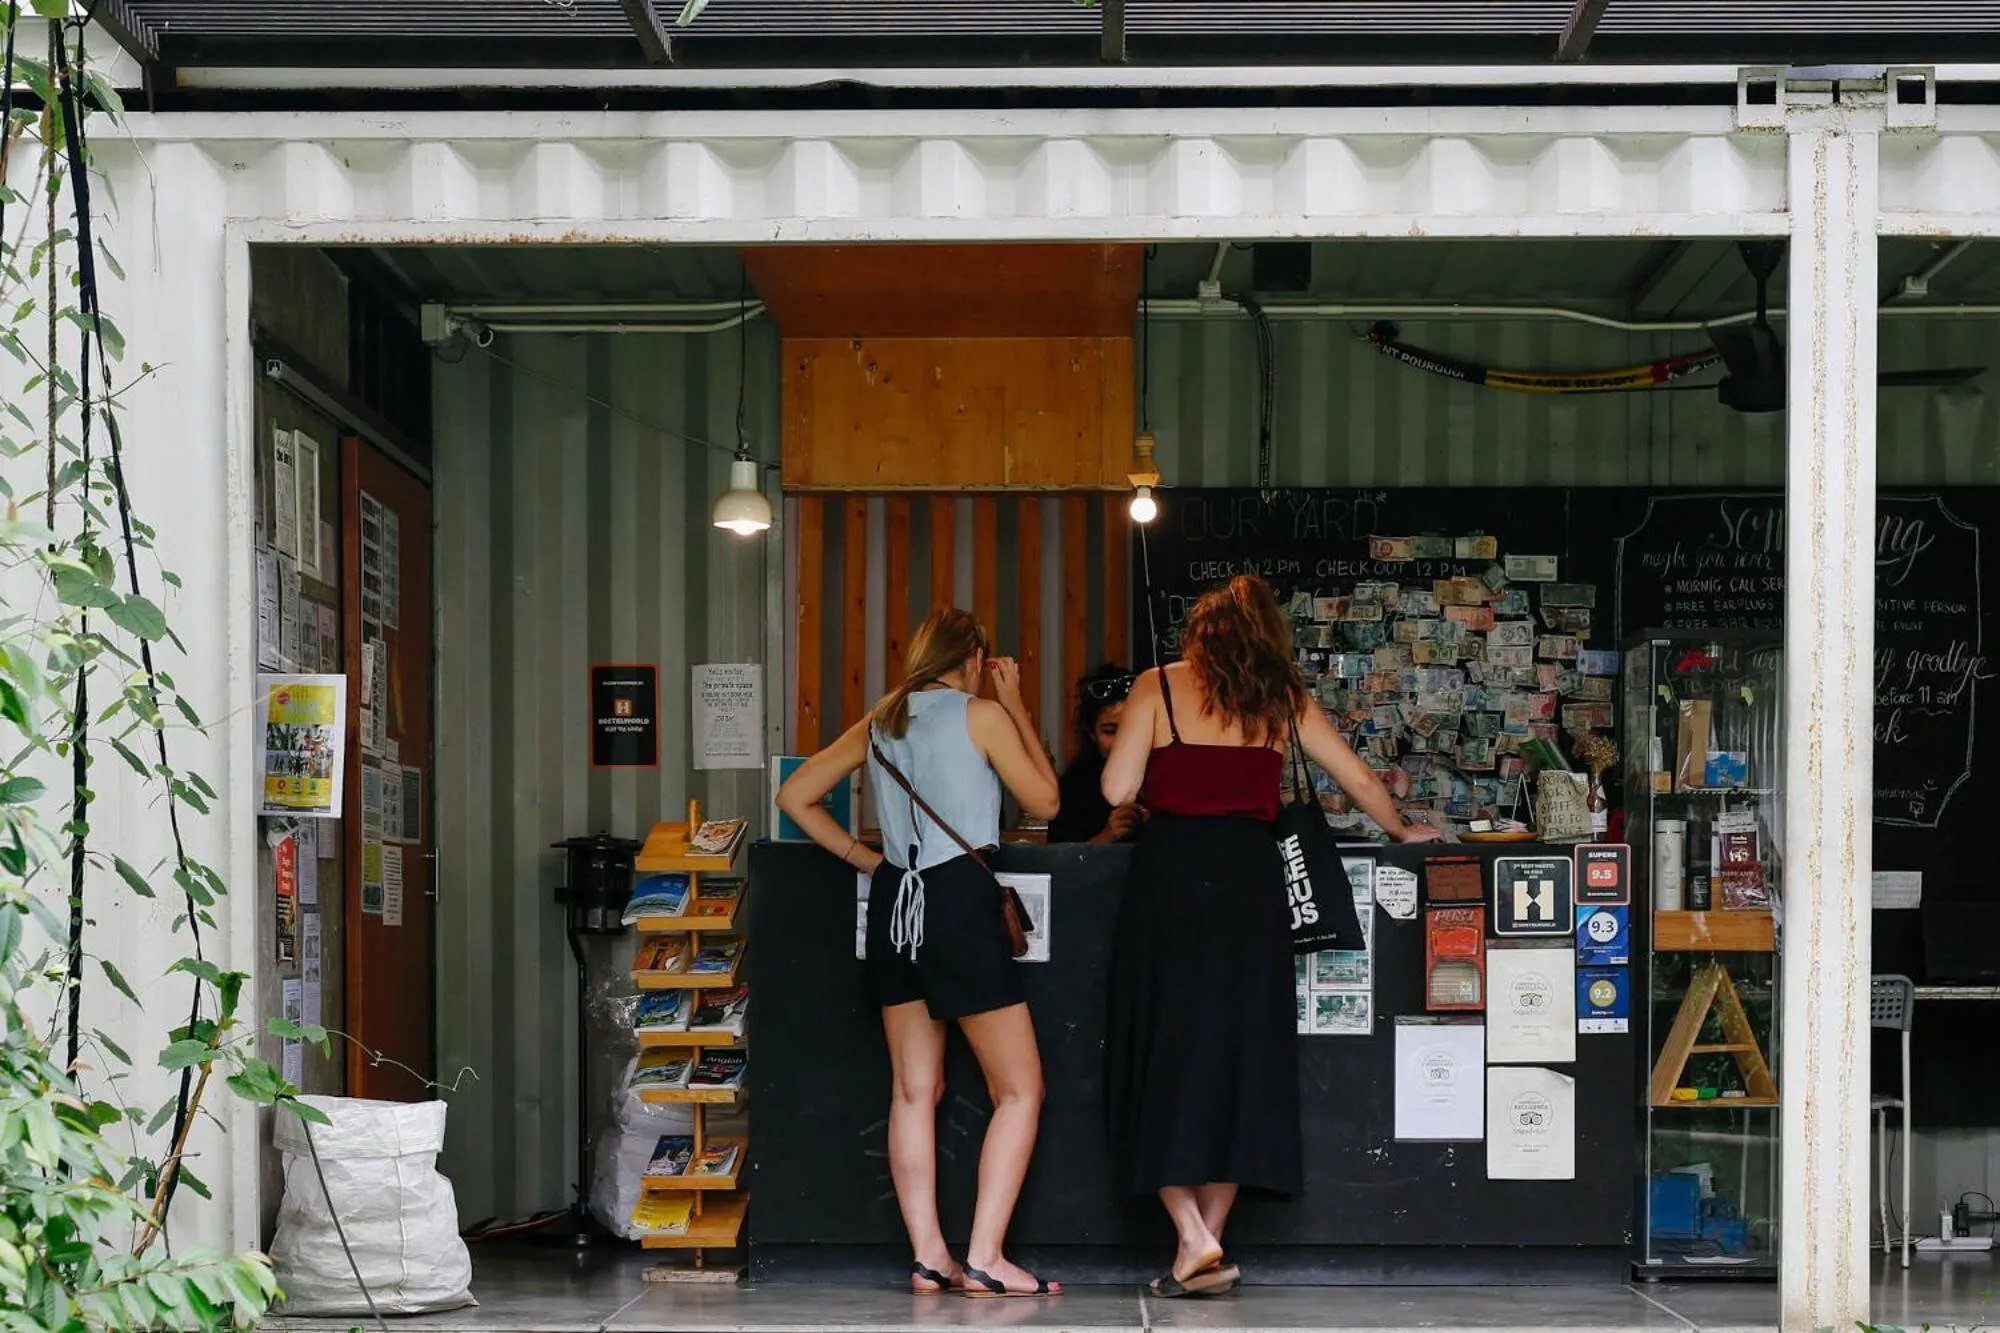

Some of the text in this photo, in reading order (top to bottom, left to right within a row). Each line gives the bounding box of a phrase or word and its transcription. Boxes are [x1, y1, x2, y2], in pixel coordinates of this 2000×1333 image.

[1181, 496, 1262, 541] OUR
[1190, 560, 1236, 582] CHECK
[1263, 559, 1273, 575] 2
[1316, 559, 1369, 577] CHECK
[1374, 560, 1406, 576] OUT
[1416, 560, 1432, 577] 12
[1440, 560, 1467, 577] PM
[1730, 578, 1757, 594] CALL
[1761, 576, 1786, 592] SER
[1675, 601, 1707, 612] FREE
[1876, 599, 1968, 614] SITIVE PERSON
[1907, 640, 1998, 694] goodbye
[1918, 685, 1931, 704] 11
[1875, 708, 1909, 744] ck
[1588, 851, 1618, 859] SUPERB
[1591, 869, 1613, 880] 9.5
[1591, 920, 1614, 934] 9.3
[1594, 987, 1612, 999] 9.2
